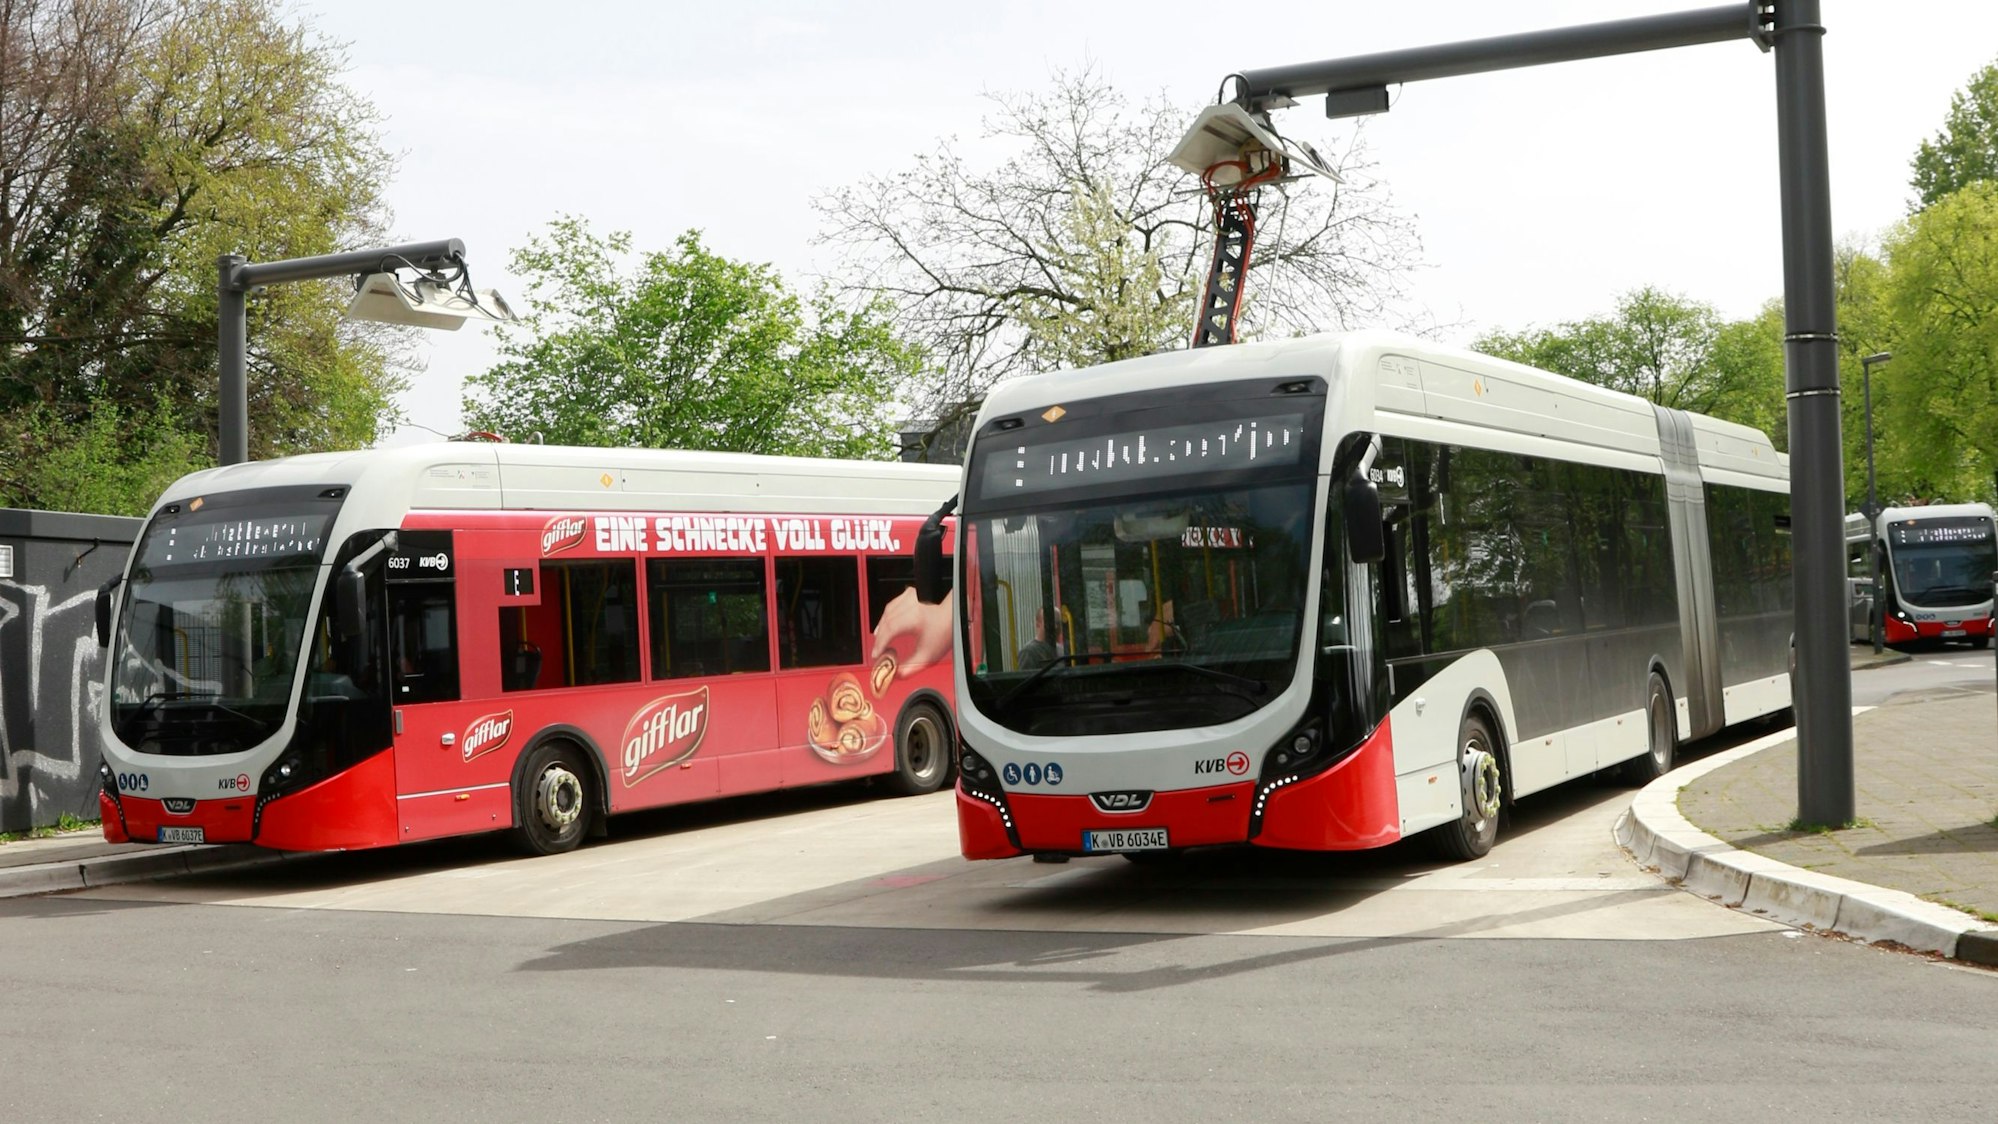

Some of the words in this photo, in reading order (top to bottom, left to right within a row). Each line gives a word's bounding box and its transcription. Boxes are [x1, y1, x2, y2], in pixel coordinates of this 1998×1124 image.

[542, 514, 586, 552] gifflar
[594, 516, 648, 551] EINE
[655, 516, 767, 553] SCHNECKE
[771, 518, 825, 551] VOLL
[831, 519, 900, 552] GLÜCK.
[387, 557, 411, 569] 6037
[418, 556, 436, 568] KVB
[464, 717, 511, 758] gifflar
[624, 702, 705, 778] gifflar
[1194, 758, 1226, 775] KVB
[218, 778, 236, 790] KVB
[167, 800, 191, 810] VDL
[1099, 793, 1143, 807] VDL
[1091, 833, 1100, 849] K
[1108, 833, 1125, 848] VB
[1127, 831, 1166, 847] 6034E
